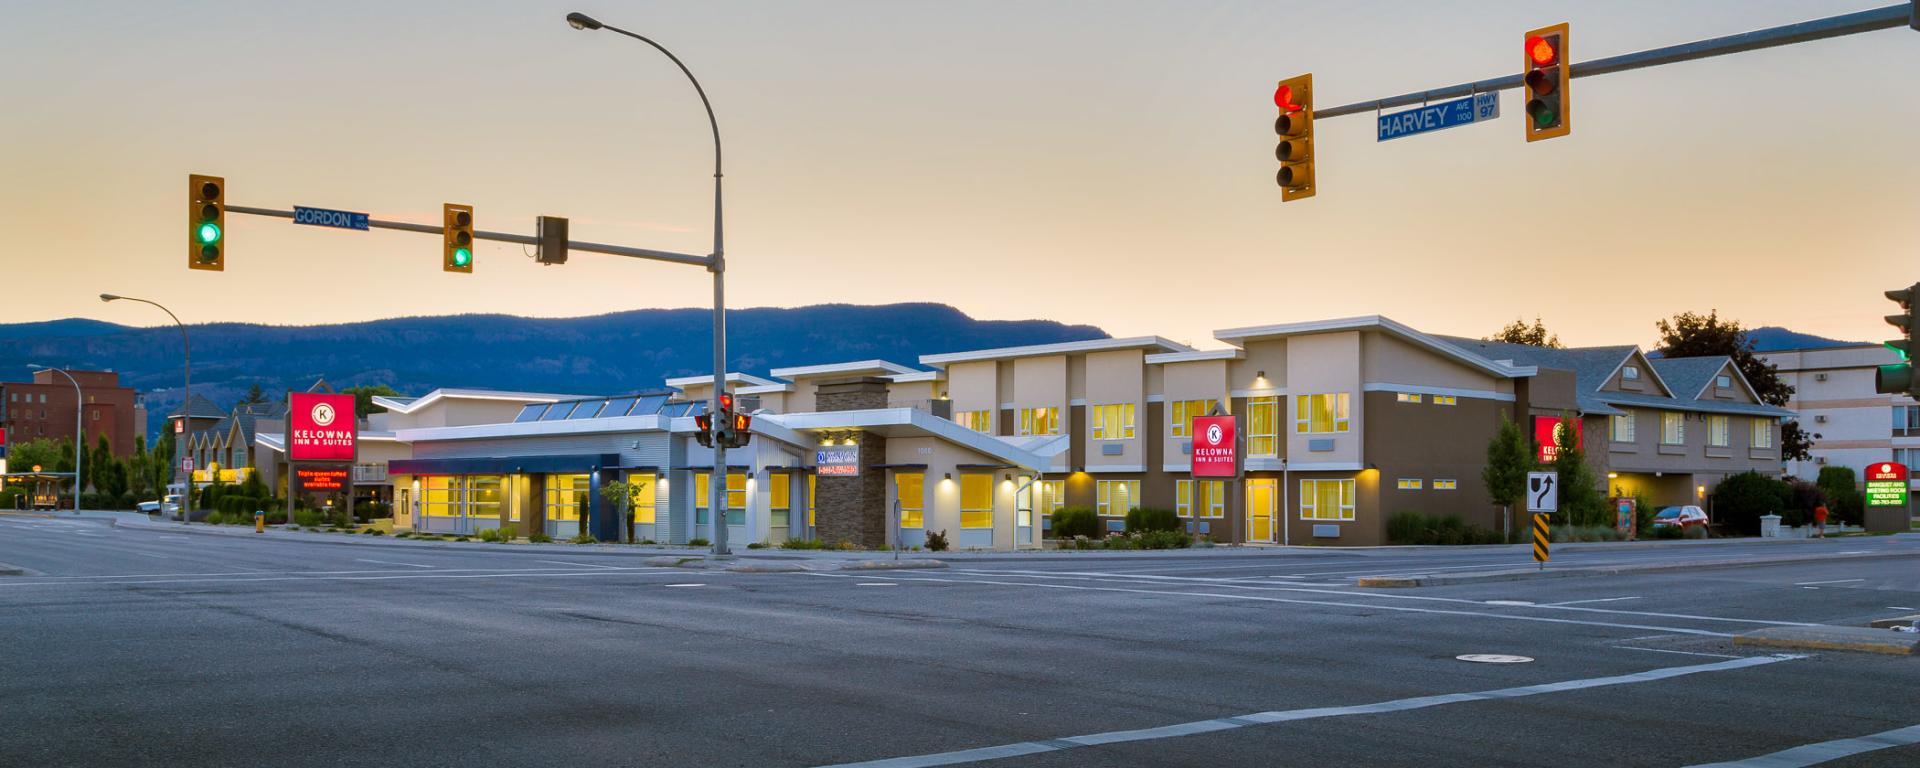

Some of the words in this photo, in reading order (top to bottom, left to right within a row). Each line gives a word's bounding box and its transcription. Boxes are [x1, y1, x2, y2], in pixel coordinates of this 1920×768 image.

[1477, 93, 1497, 106] HWY
[1456, 101, 1470, 111] AVE
[1480, 104, 1495, 118] 97
[1379, 105, 1448, 138] HARVEY
[295, 208, 351, 227] GORDON
[319, 409, 327, 420] K
[294, 430, 352, 439] KELOWNA
[1211, 430, 1218, 440] K
[1196, 448, 1233, 456] KELOWNA
